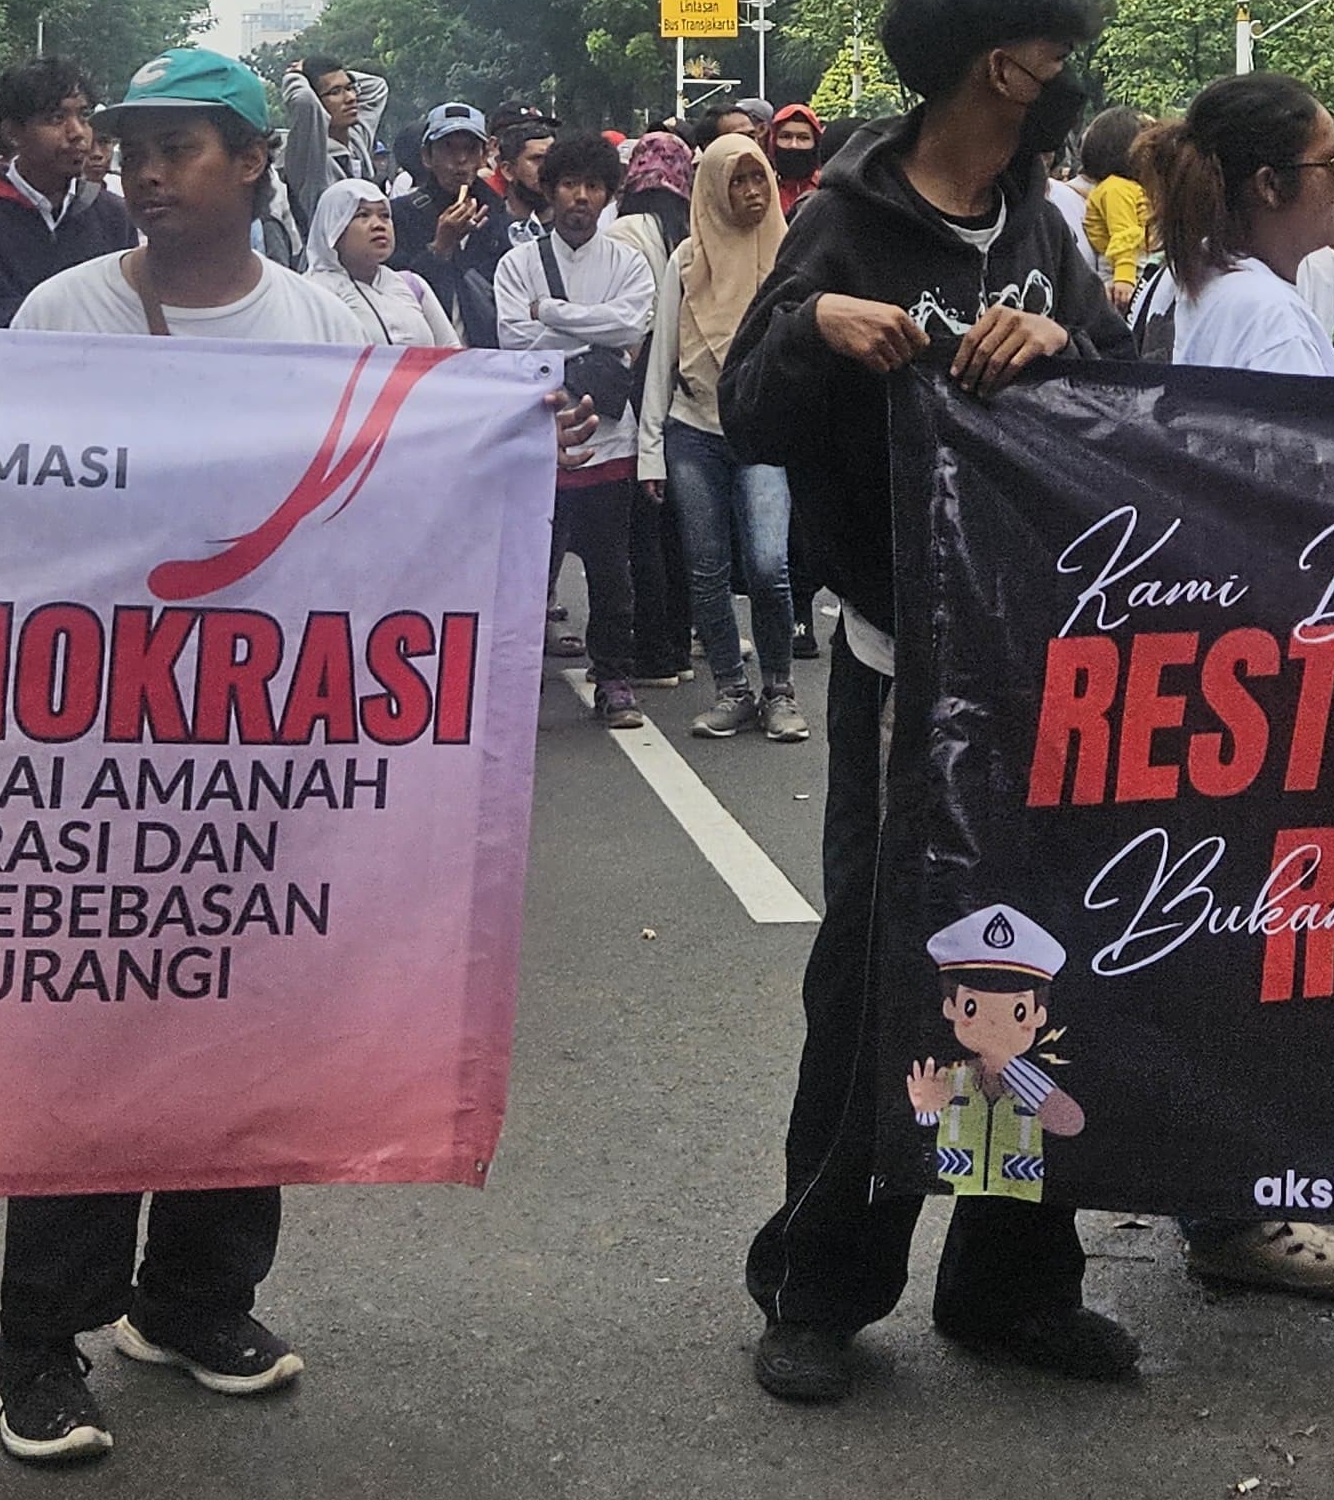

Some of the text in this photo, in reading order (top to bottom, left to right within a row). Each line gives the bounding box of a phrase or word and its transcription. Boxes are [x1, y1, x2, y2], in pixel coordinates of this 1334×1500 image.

[664, 18, 678, 31] Bus
[680, 0, 718, 13] Lintasan
[1057, 505, 1248, 638] Kami
[81, 758, 389, 810] AMANAH
[134, 821, 279, 874] DAN
